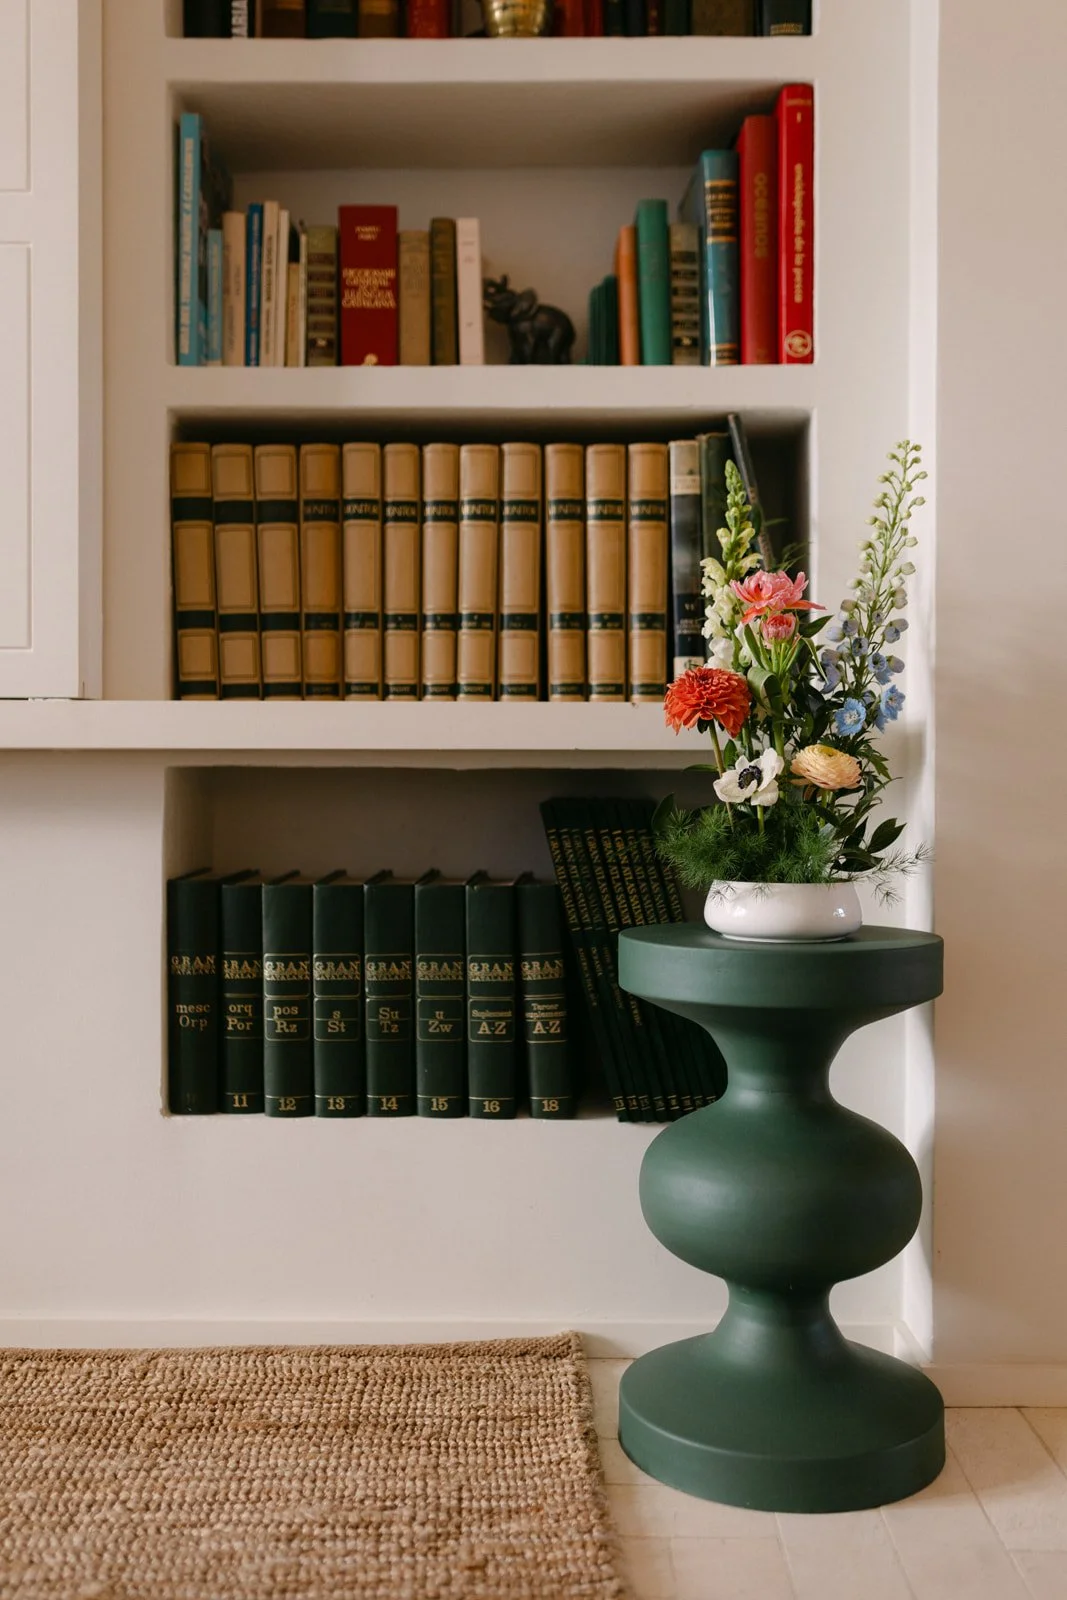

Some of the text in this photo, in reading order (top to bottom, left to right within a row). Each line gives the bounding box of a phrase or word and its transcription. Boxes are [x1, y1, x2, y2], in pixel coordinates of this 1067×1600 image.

[171, 955, 216, 966] GRAN
[264, 961, 311, 971] GRAN
[314, 961, 361, 971] GRAN
[366, 961, 412, 971] GRAN
[418, 961, 463, 971] GRAN
[469, 962, 514, 972] GRAN
[520, 960, 564, 970] GRAN
[175, 1003, 211, 1014] mesc
[228, 1003, 253, 1018] orq
[273, 1006, 299, 1020] pos
[332, 1010, 341, 1019] s
[378, 1007, 400, 1020] Su
[435, 1011, 445, 1020] u
[179, 1015, 208, 1031] Orp
[227, 1017, 253, 1031] Por
[275, 1020, 298, 1033] Rz
[328, 1020, 346, 1033] St
[380, 1020, 400, 1033] Tz
[428, 1020, 454, 1033] Zw
[477, 1021, 507, 1034] A-Z
[532, 1020, 561, 1034] A-Z
[232, 1094, 249, 1108] 11
[278, 1097, 297, 1111] 12
[327, 1097, 345, 1110] 13
[380, 1097, 399, 1111] 14
[430, 1098, 449, 1111] 15
[482, 1100, 501, 1113] 16
[541, 1099, 560, 1112] 18
